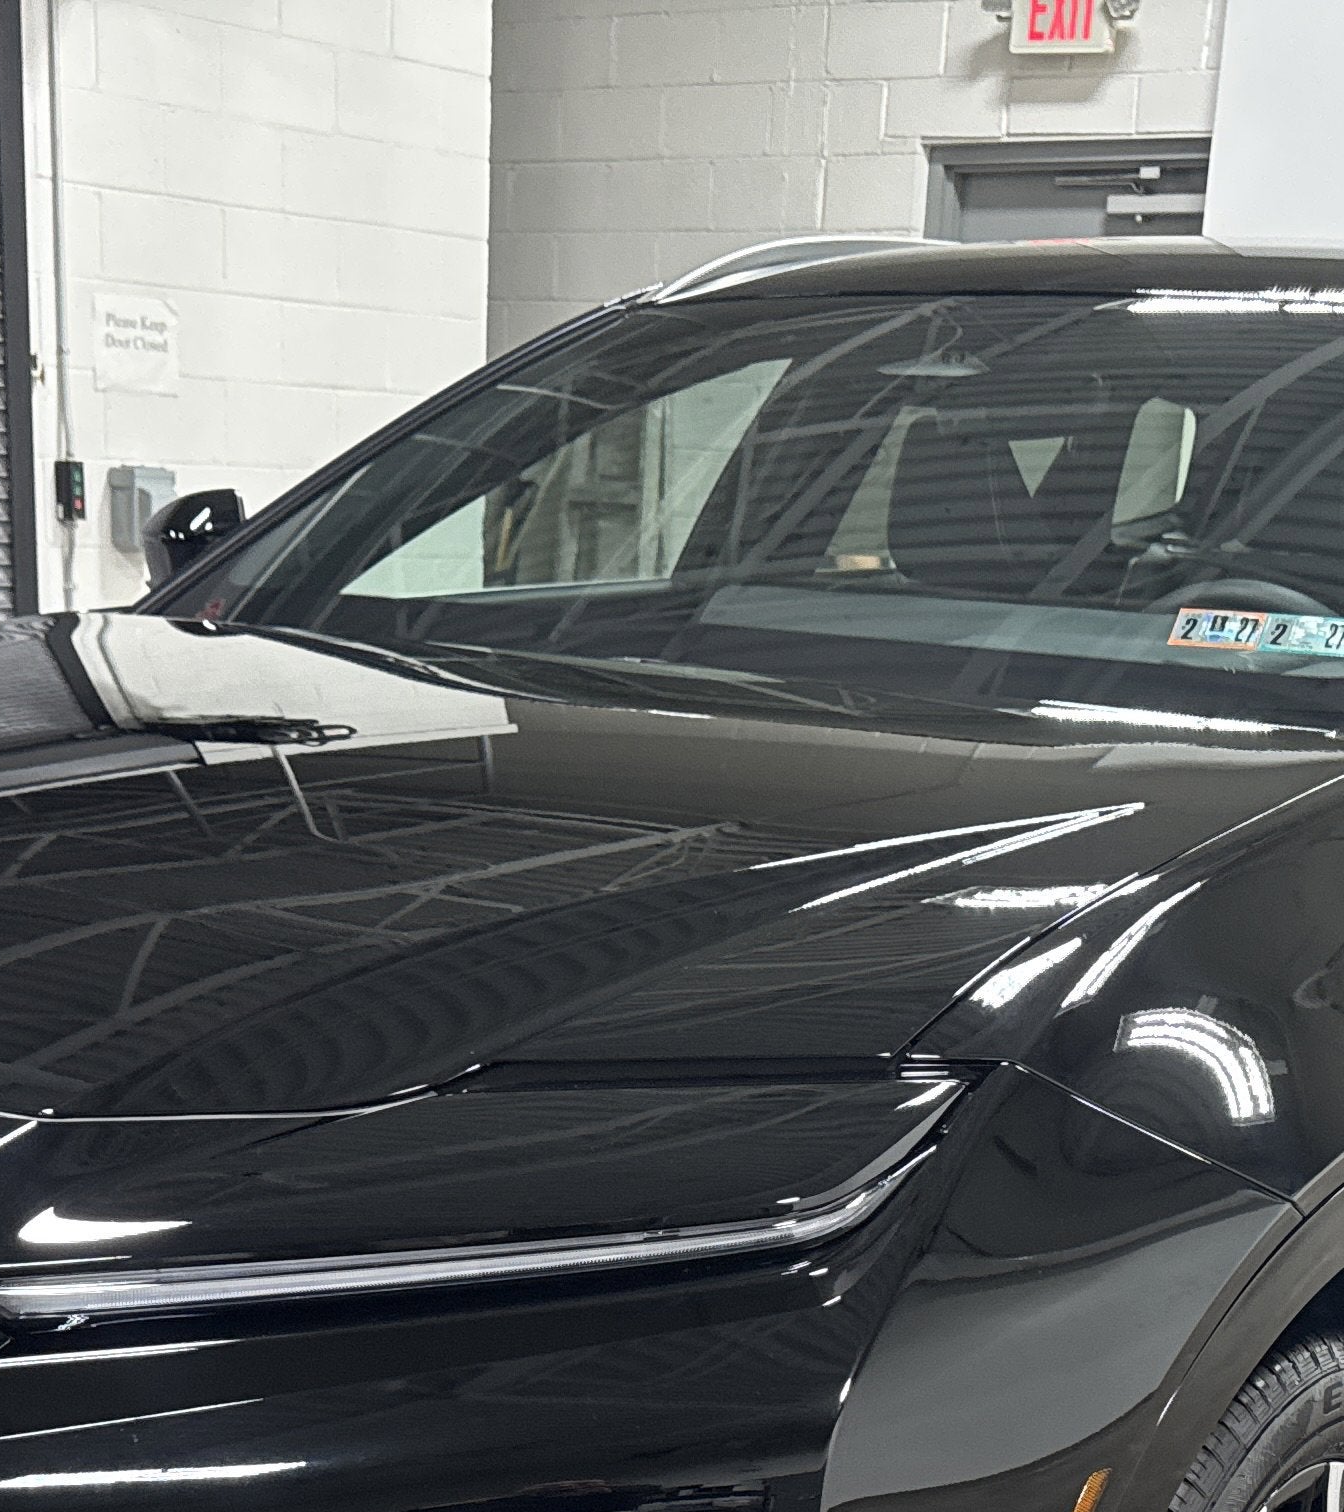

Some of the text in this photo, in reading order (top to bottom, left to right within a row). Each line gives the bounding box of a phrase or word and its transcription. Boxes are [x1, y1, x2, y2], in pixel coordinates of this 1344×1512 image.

[1028, 0, 1093, 41] EXIT
[1181, 617, 1199, 640] 2
[1235, 617, 1260, 643] 27
[1269, 623, 1288, 646] 2
